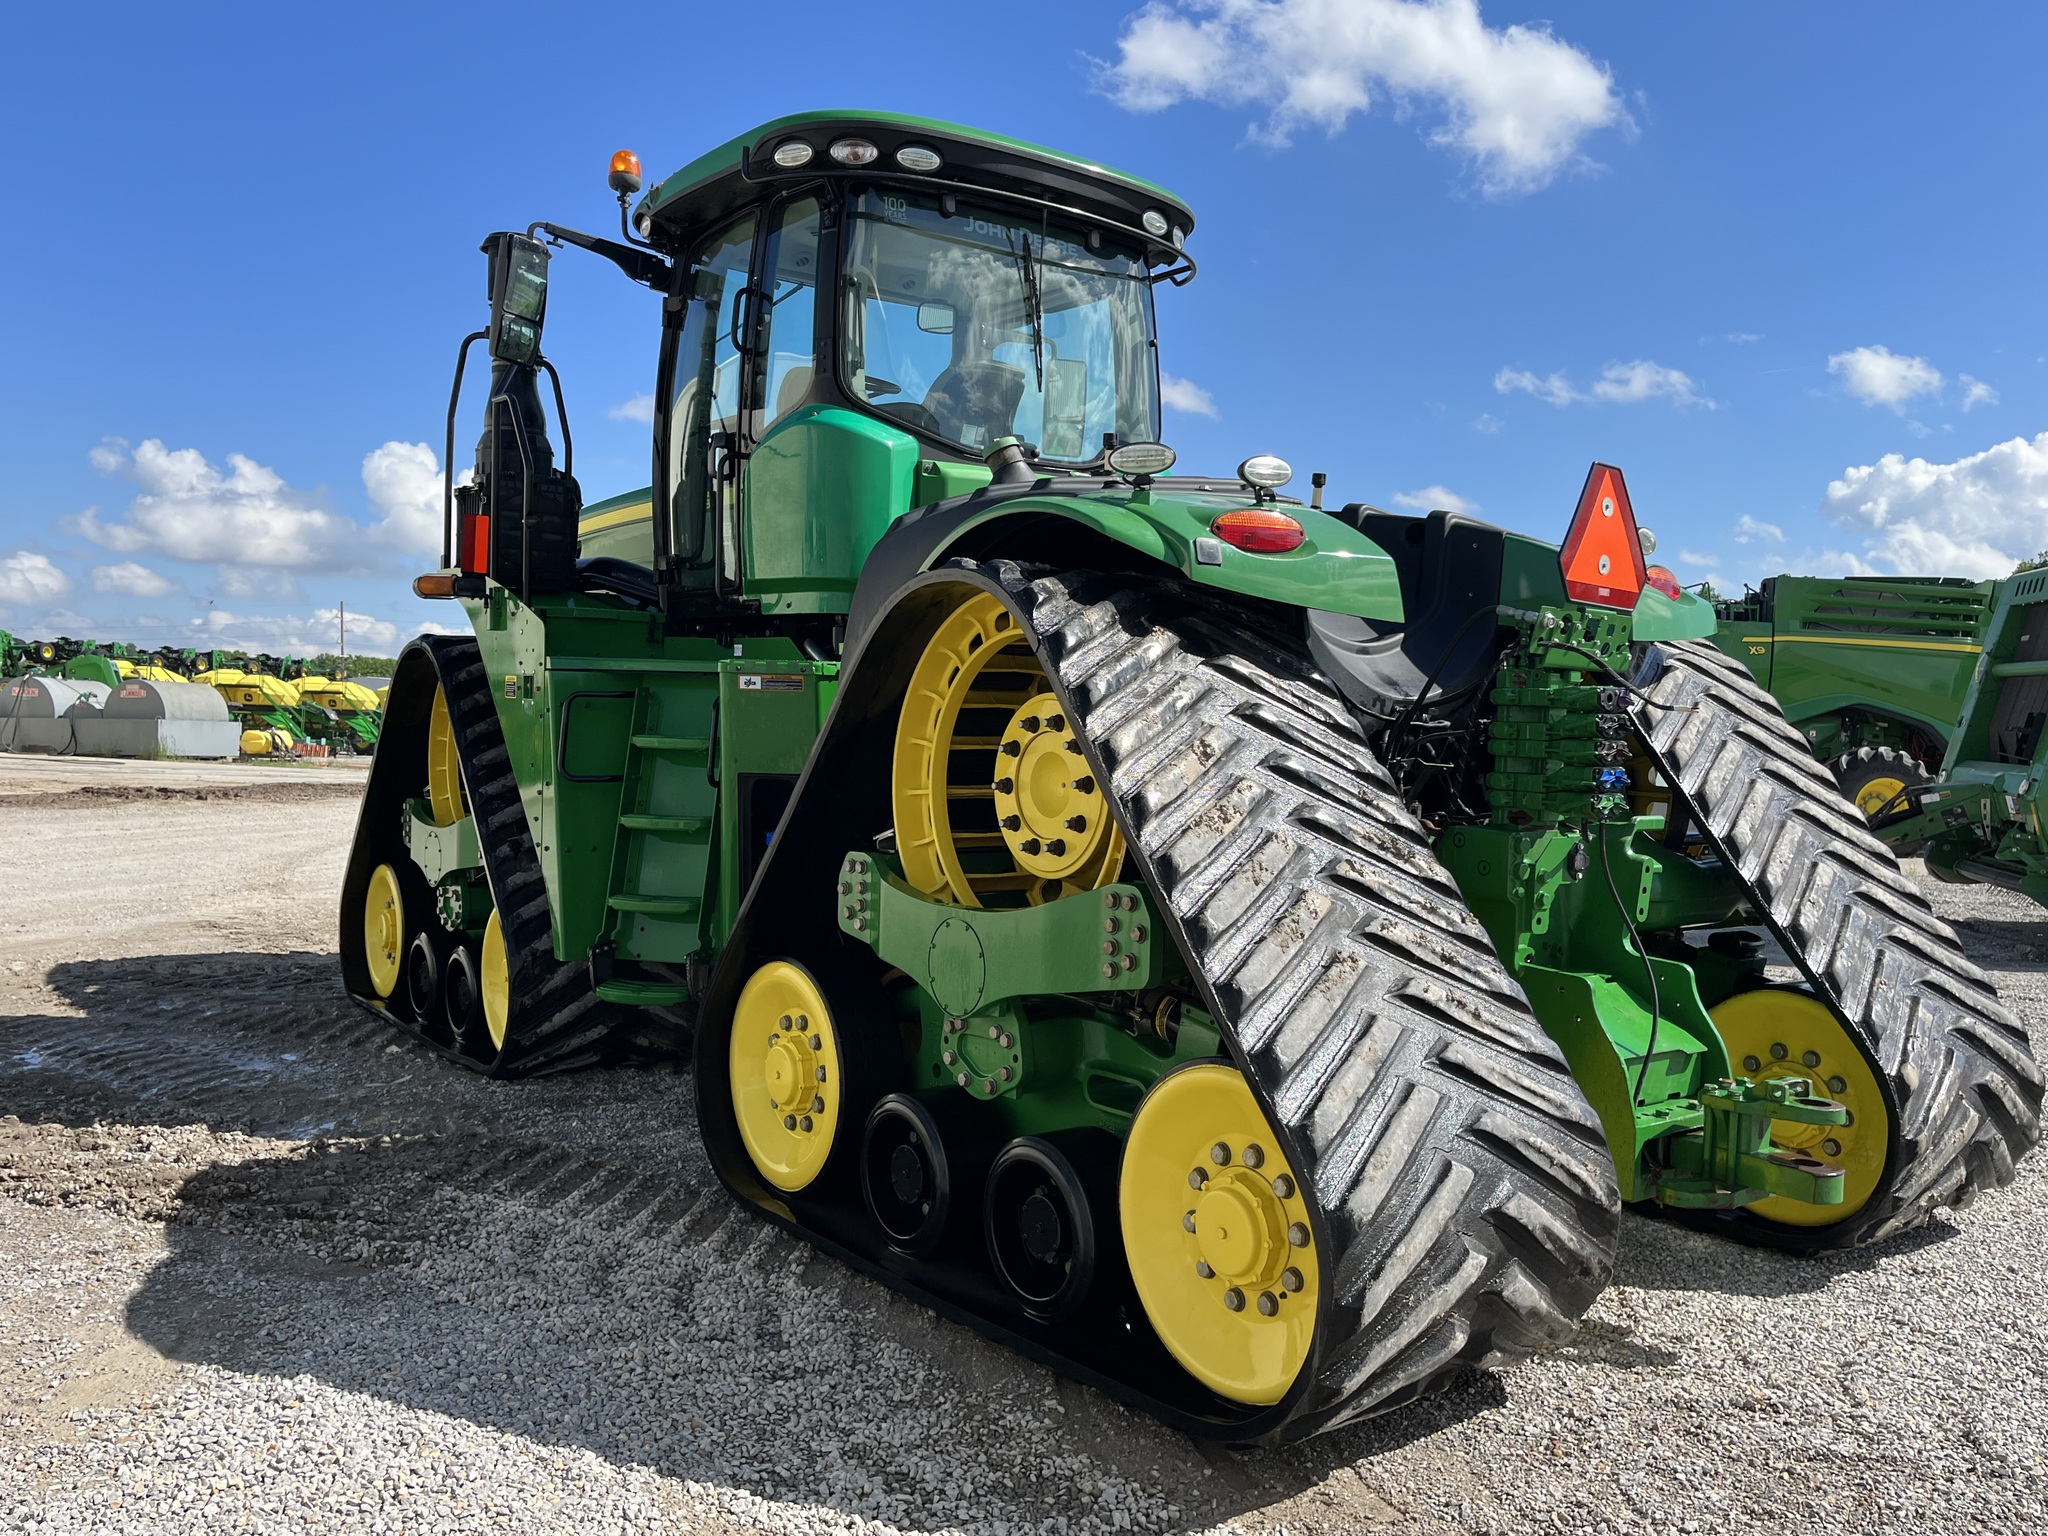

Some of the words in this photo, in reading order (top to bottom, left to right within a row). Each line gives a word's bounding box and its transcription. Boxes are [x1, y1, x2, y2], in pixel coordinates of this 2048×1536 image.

[883, 197, 906, 212] 100
[884, 210, 907, 220] YEARS
[963, 216, 1015, 241] JOHN
[1019, 227, 1078, 256] DEERE
[1748, 645, 1766, 655] X9
